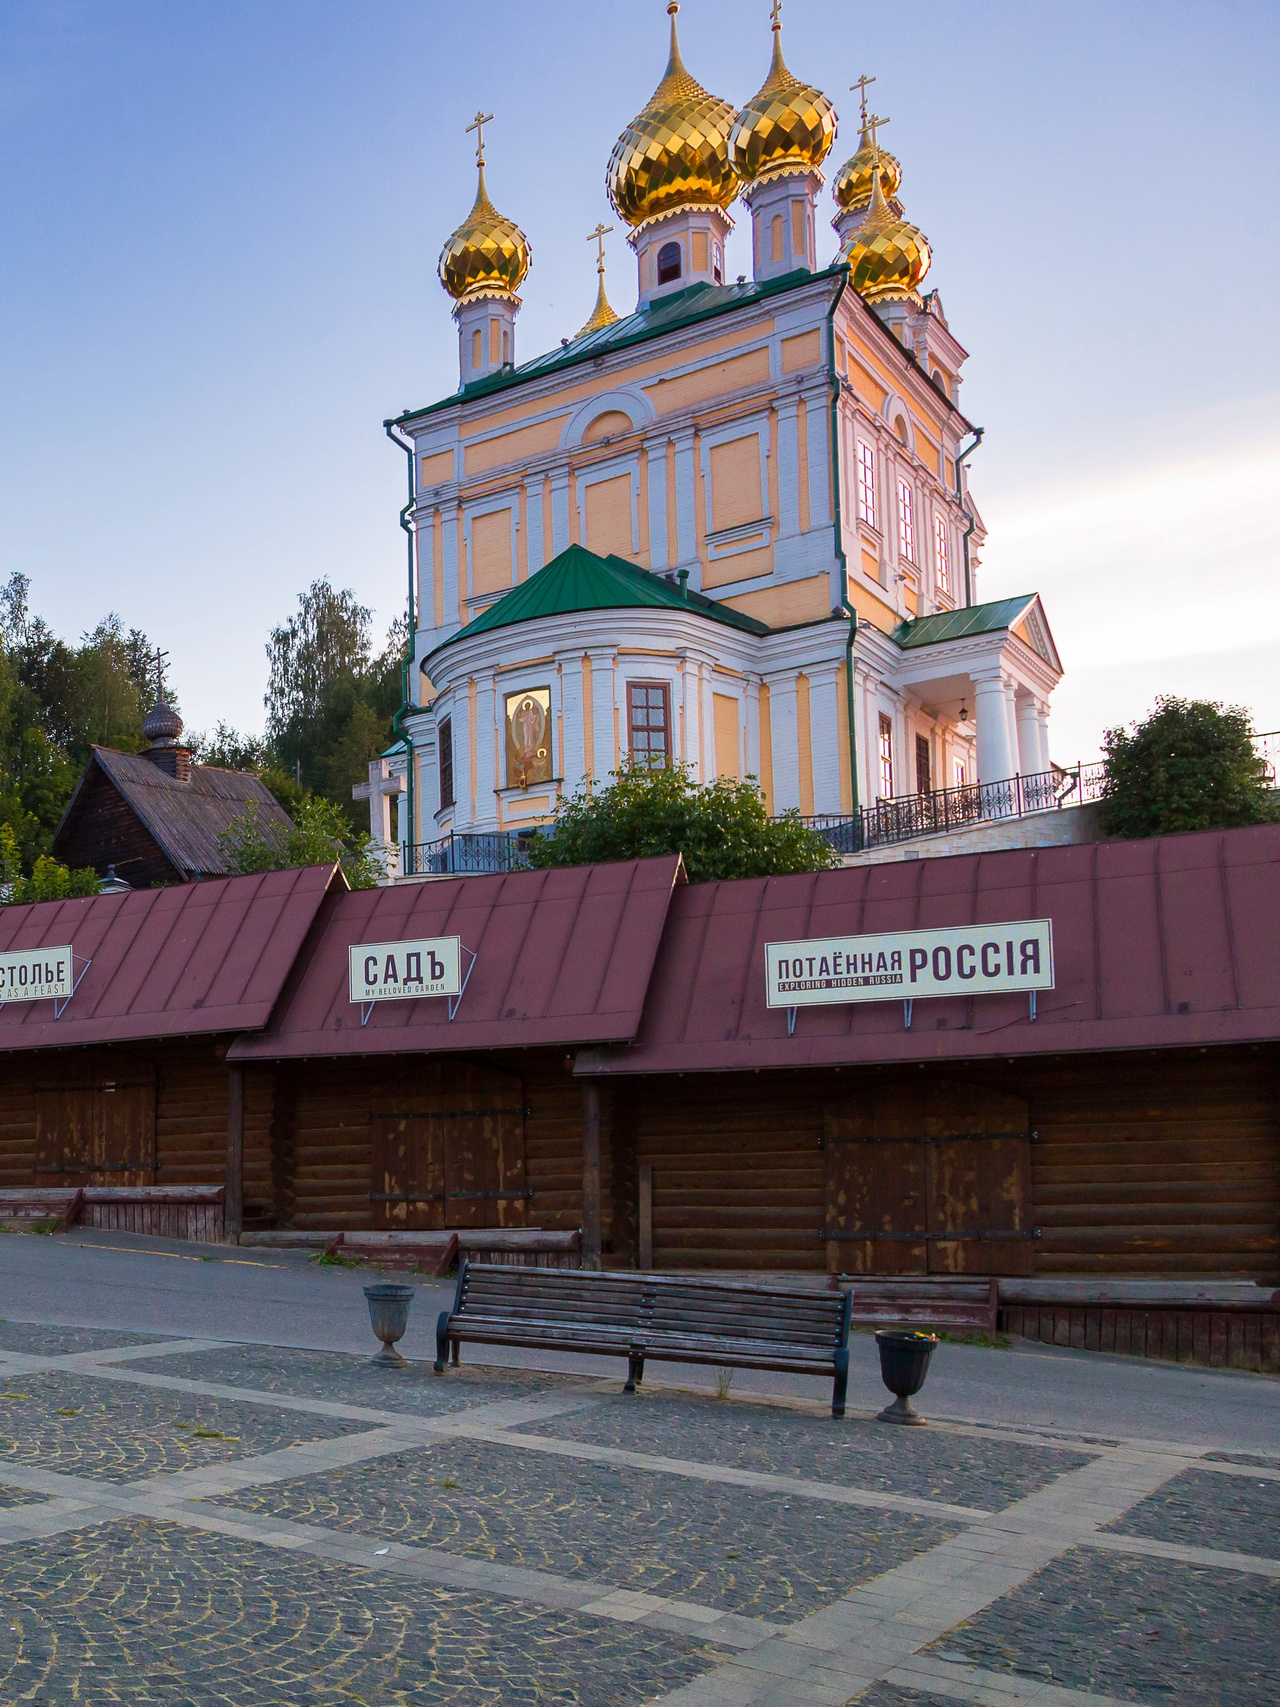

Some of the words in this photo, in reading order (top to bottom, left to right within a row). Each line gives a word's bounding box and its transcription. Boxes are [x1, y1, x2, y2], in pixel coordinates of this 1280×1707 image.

[364, 950, 445, 986] САДЪ
[778, 951, 902, 980] ПОТАЁННАЯ
[909, 938, 1041, 983] РОССІЯ
[7, 988, 19, 998] AS
[24, 987, 29, 997] A
[34, 983, 65, 996] FEAST
[379, 986, 411, 996] BELOVED
[415, 983, 445, 993] GARDEN
[779, 981, 826, 991] EXPLORING
[831, 977, 864, 988] HIDDEN
[869, 974, 902, 984] RUSSIA
